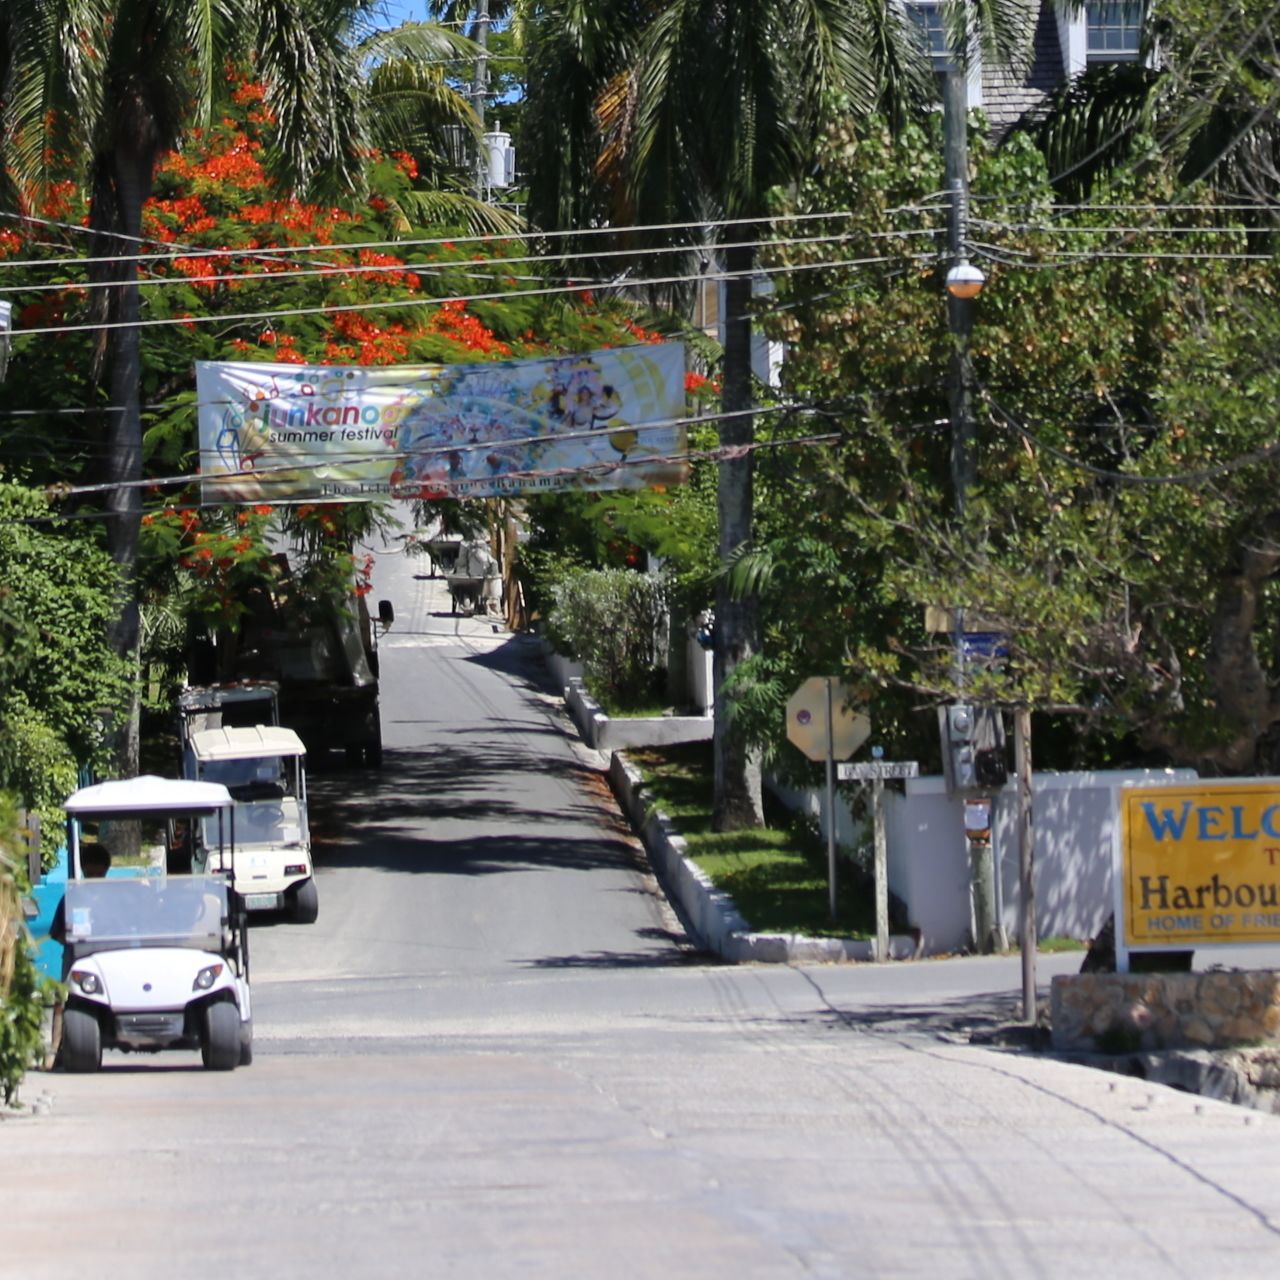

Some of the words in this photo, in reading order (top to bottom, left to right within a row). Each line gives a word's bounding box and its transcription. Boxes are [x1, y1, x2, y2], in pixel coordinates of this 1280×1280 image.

[270, 431, 335, 443] summer
[341, 426, 398, 442] festival
[1147, 913, 1203, 931] HOME
[1211, 912, 1234, 929] OF
